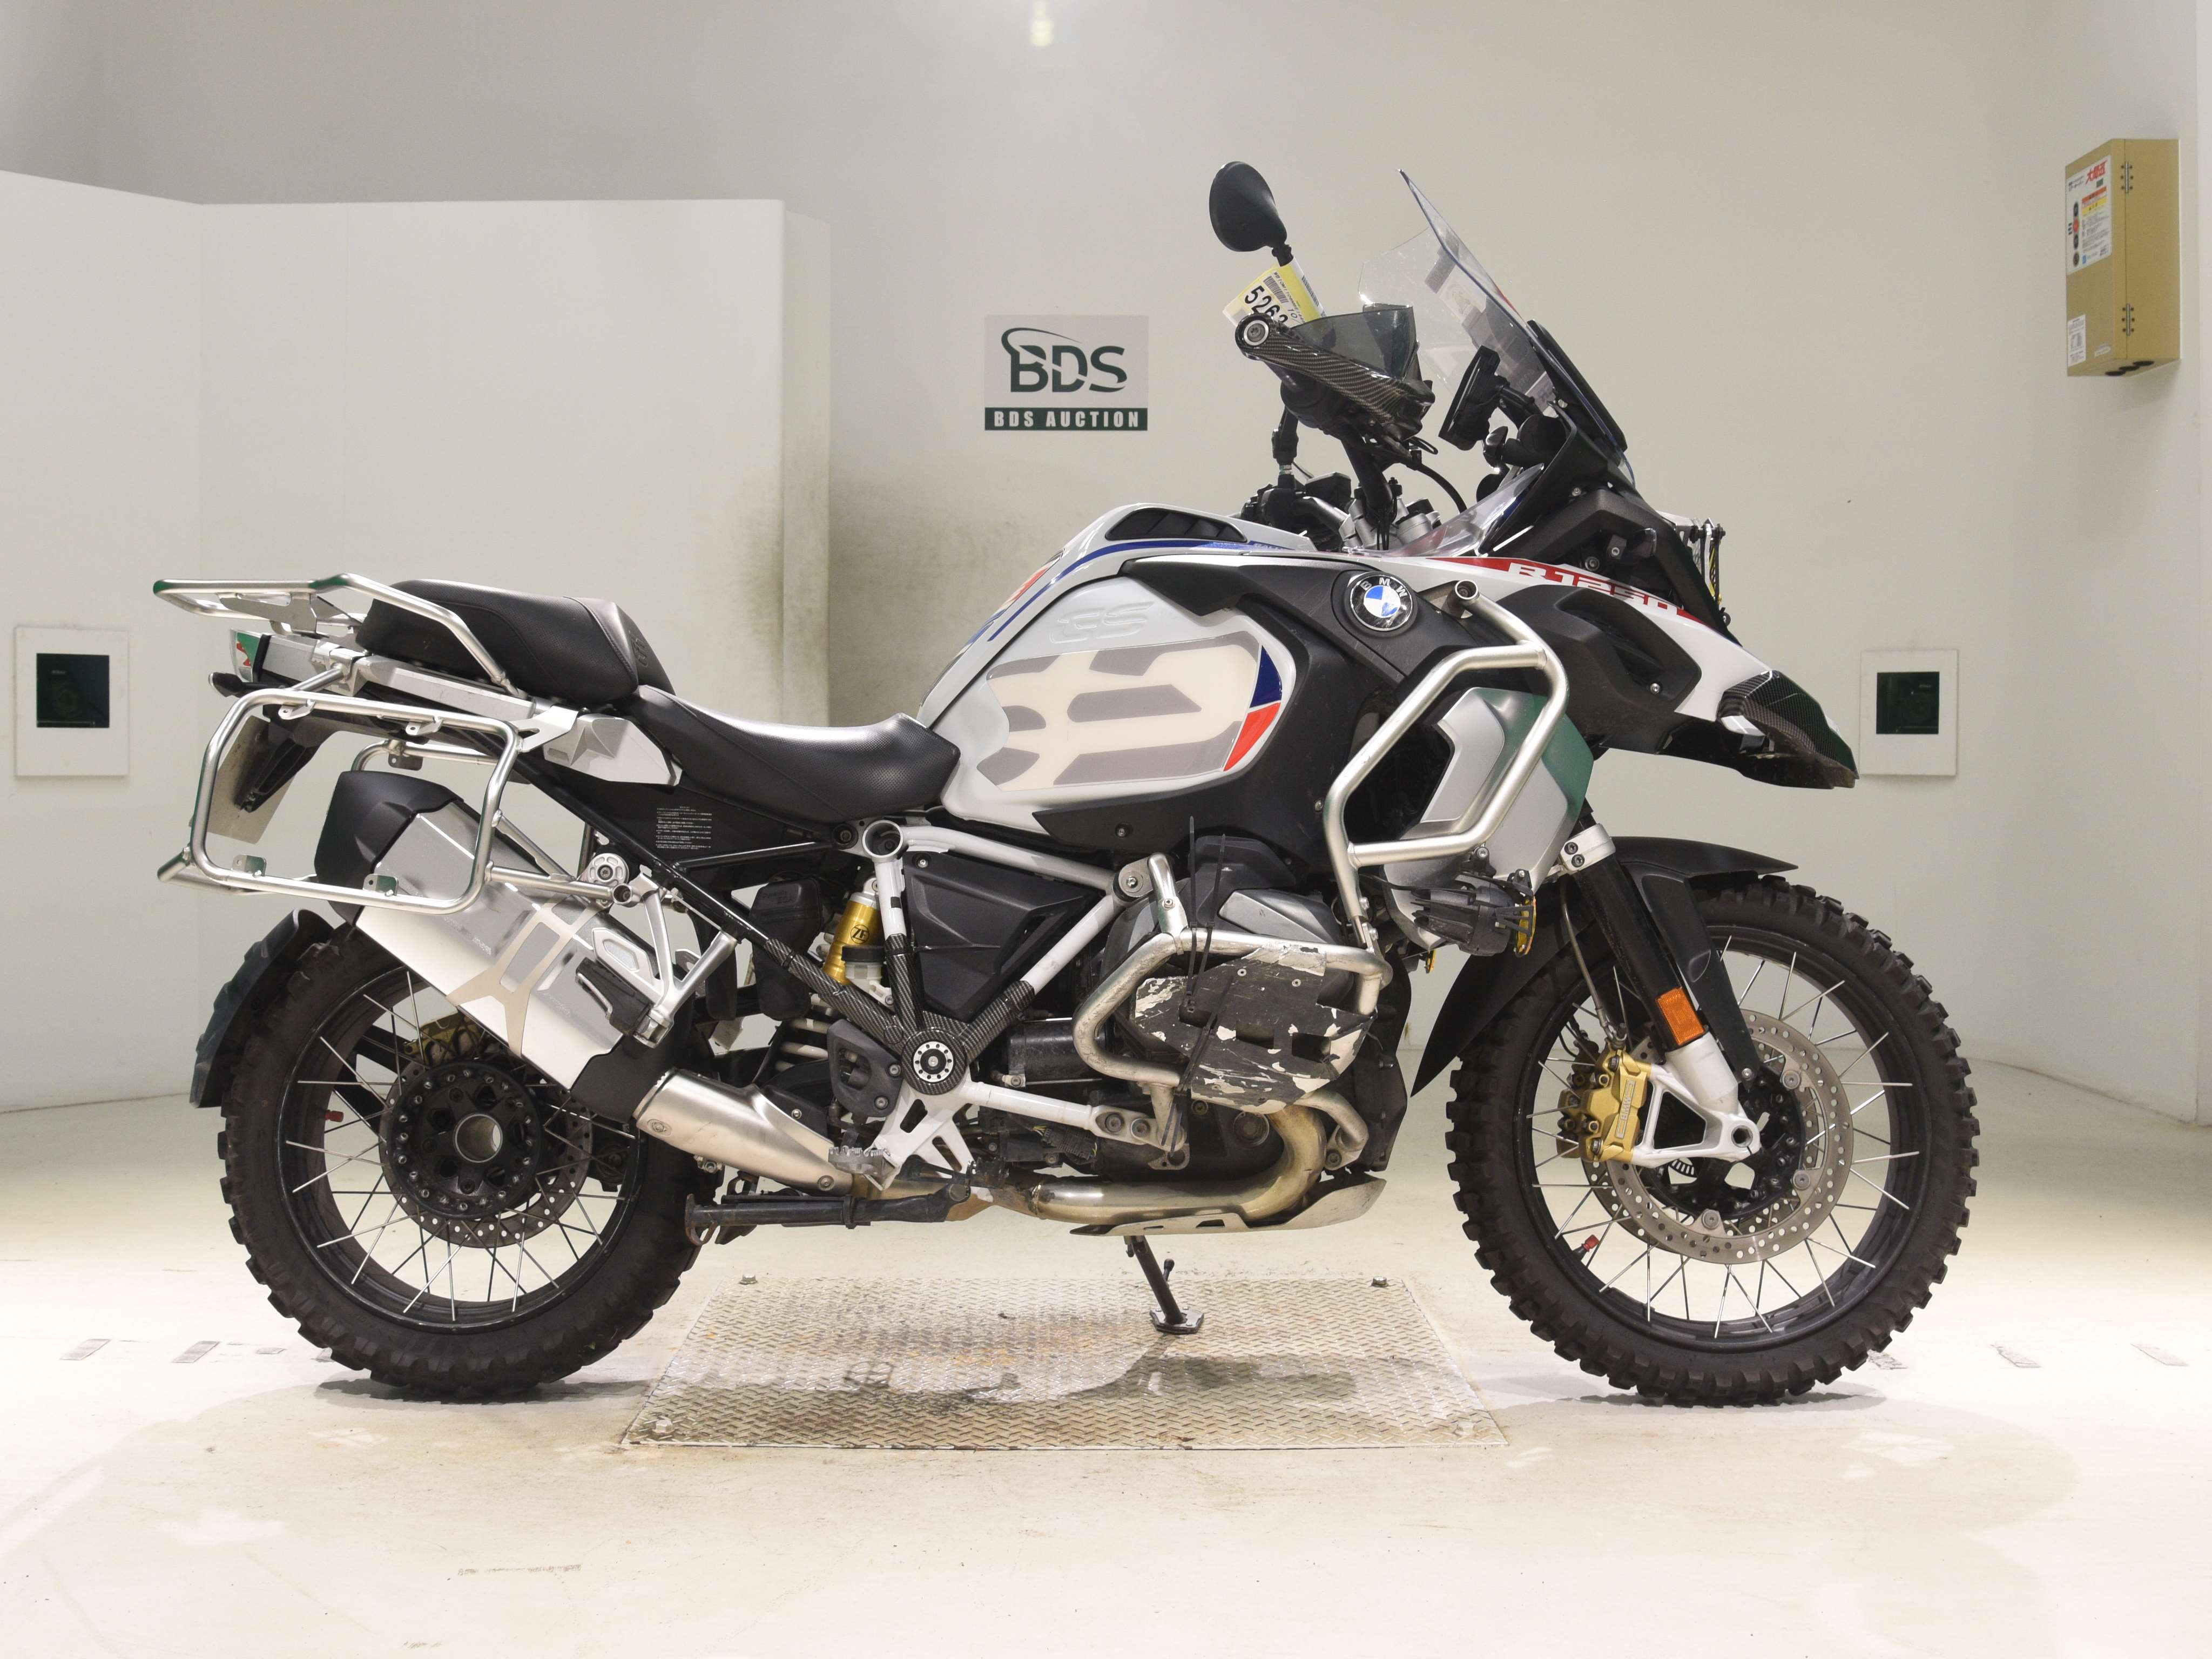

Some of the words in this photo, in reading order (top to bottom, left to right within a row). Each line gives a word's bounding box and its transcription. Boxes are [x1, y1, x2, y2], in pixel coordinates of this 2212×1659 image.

[1001, 327, 1127, 392] BDS
[994, 411, 1034, 427] BDS
[1046, 411, 1139, 427] AUCTION
[1360, 577, 1408, 598] BMW
[1049, 601, 1155, 644] GS
[852, 926, 869, 942] ZF
[1620, 1097, 1631, 1121] BMW
